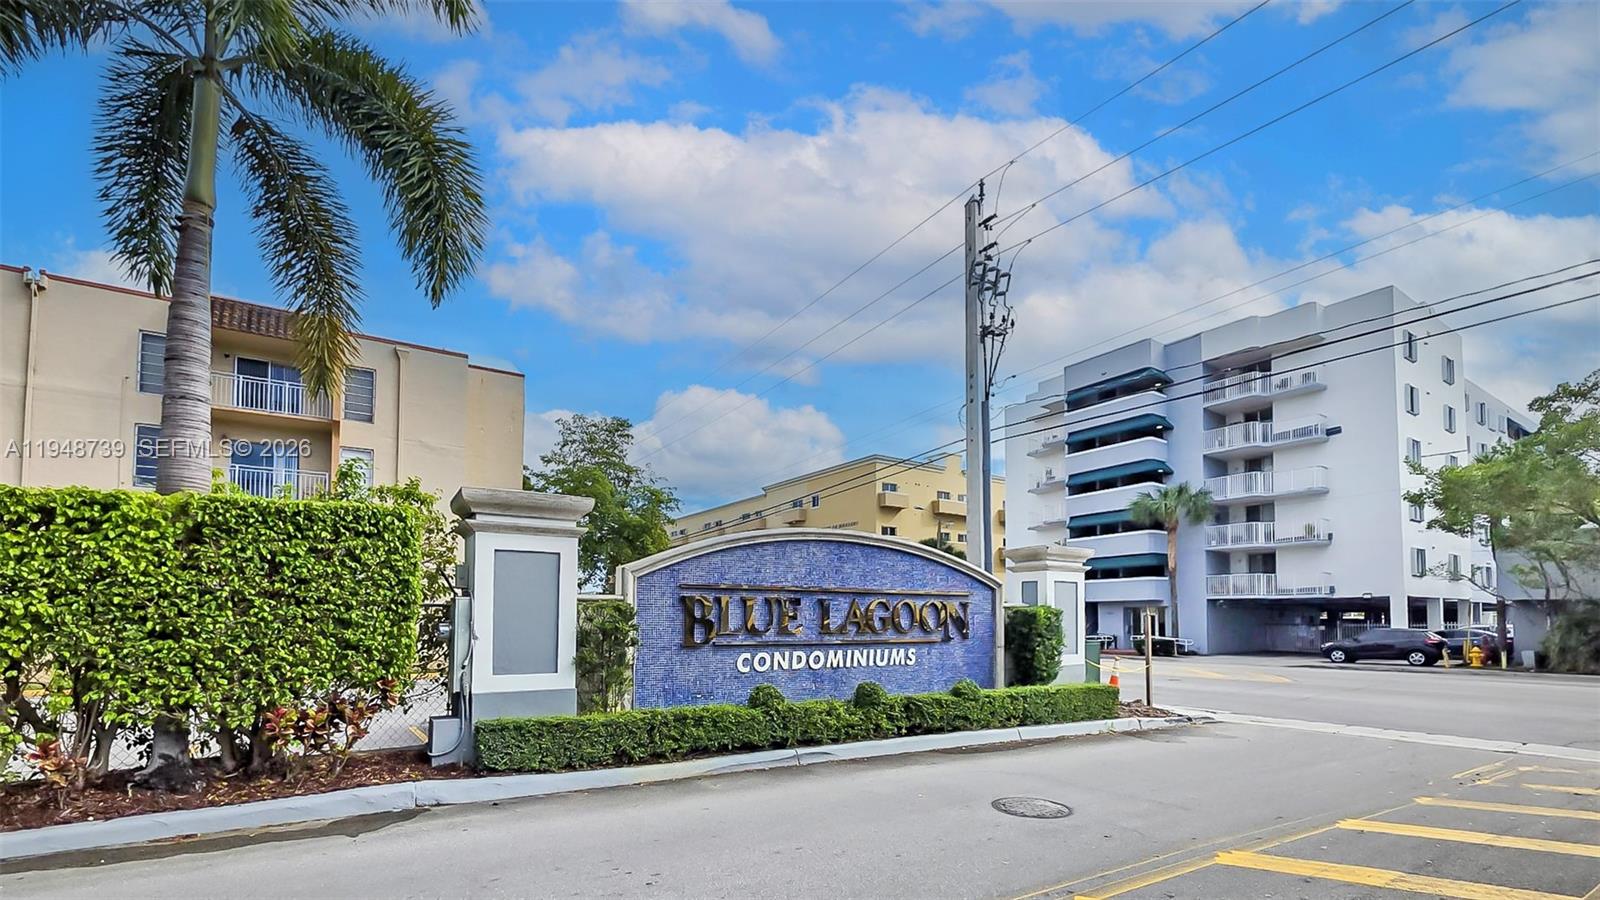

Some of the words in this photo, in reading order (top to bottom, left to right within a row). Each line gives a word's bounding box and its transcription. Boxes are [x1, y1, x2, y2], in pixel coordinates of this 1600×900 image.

[680, 594, 803, 648] BLUE
[818, 597, 970, 641] LAGOON
[735, 648, 917, 673] CONDOMINIUMS
